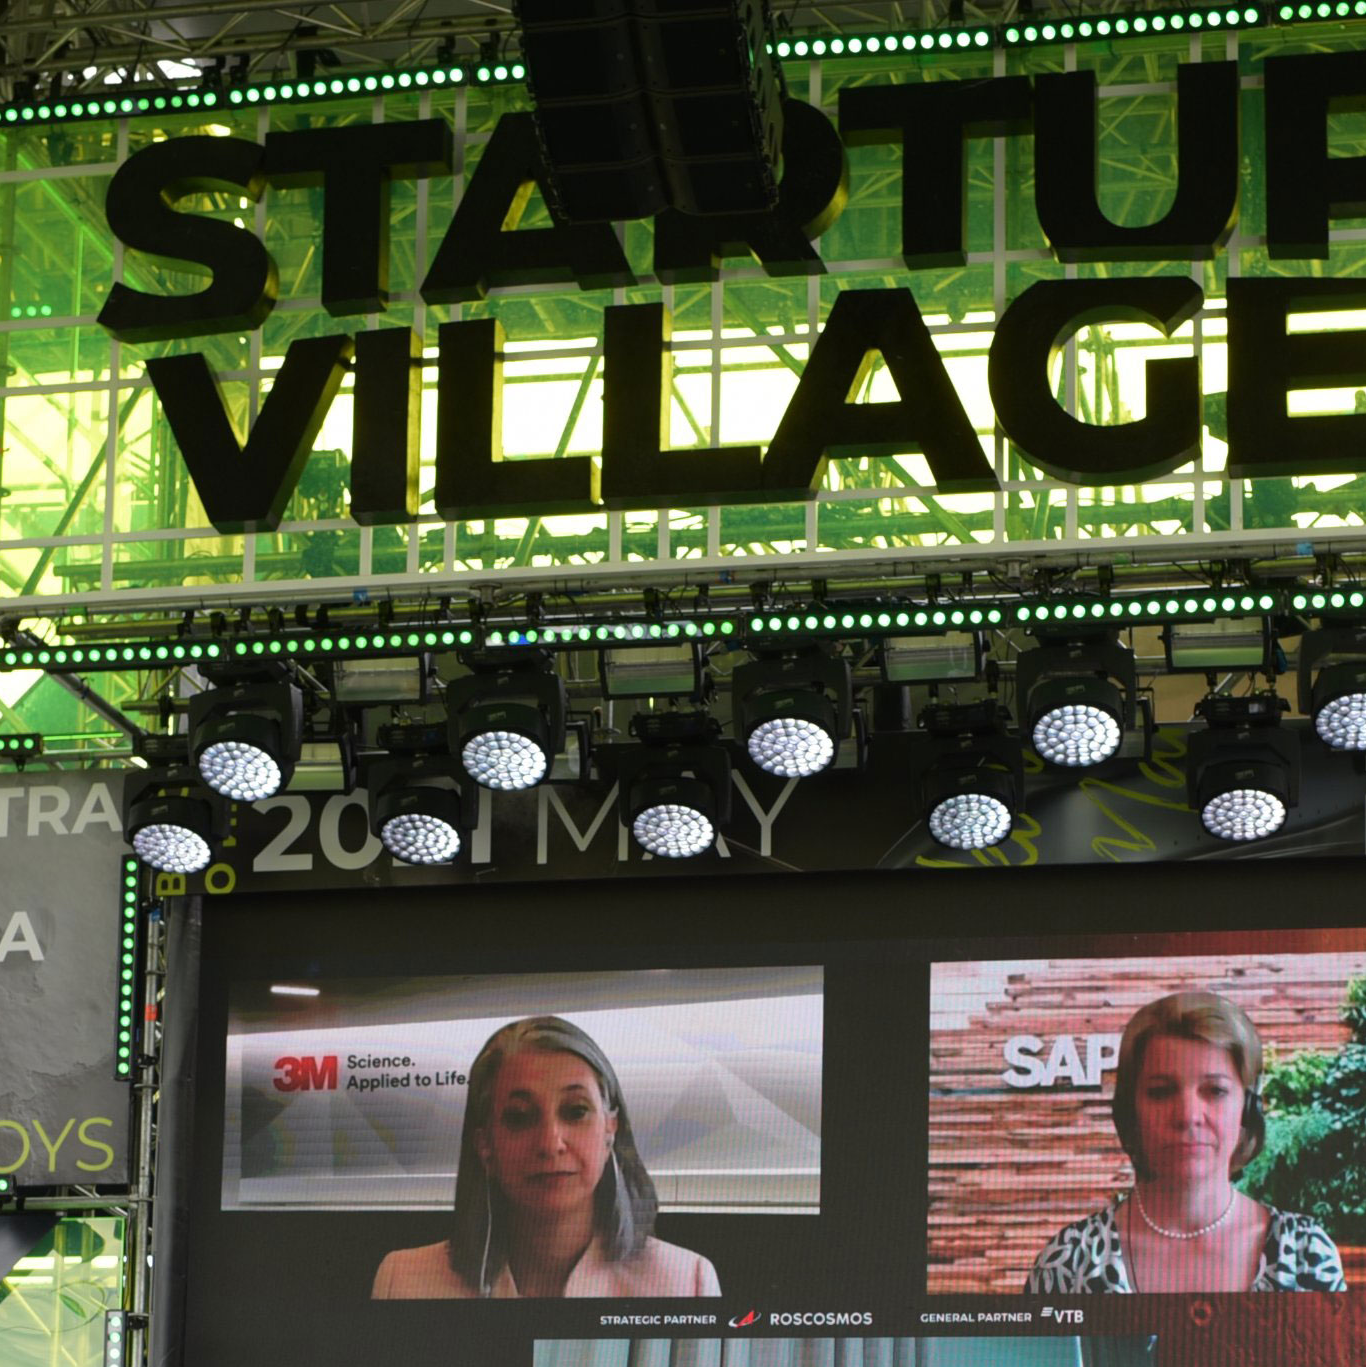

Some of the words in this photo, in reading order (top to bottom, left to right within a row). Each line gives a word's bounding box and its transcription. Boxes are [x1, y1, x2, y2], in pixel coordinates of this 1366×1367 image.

[252, 776, 492, 872] 201
[537, 769, 803, 865] MY
[273, 1055, 338, 1092] 3M
[347, 1054, 415, 1070] Science.
[1001, 1034, 1119, 1087] SAP
[346, 1072, 410, 1092] Applied
[415, 1073, 431, 1087] to
[600, 1314, 661, 1326] STRATEGIC
[664, 1314, 717, 1325] PARTNER
[770, 1311, 873, 1326] ROSCOSMOS
[920, 1312, 975, 1324] GENERAL
[978, 1312, 1032, 1323] PARTNER
[1054, 1310, 1084, 1324] VTB
